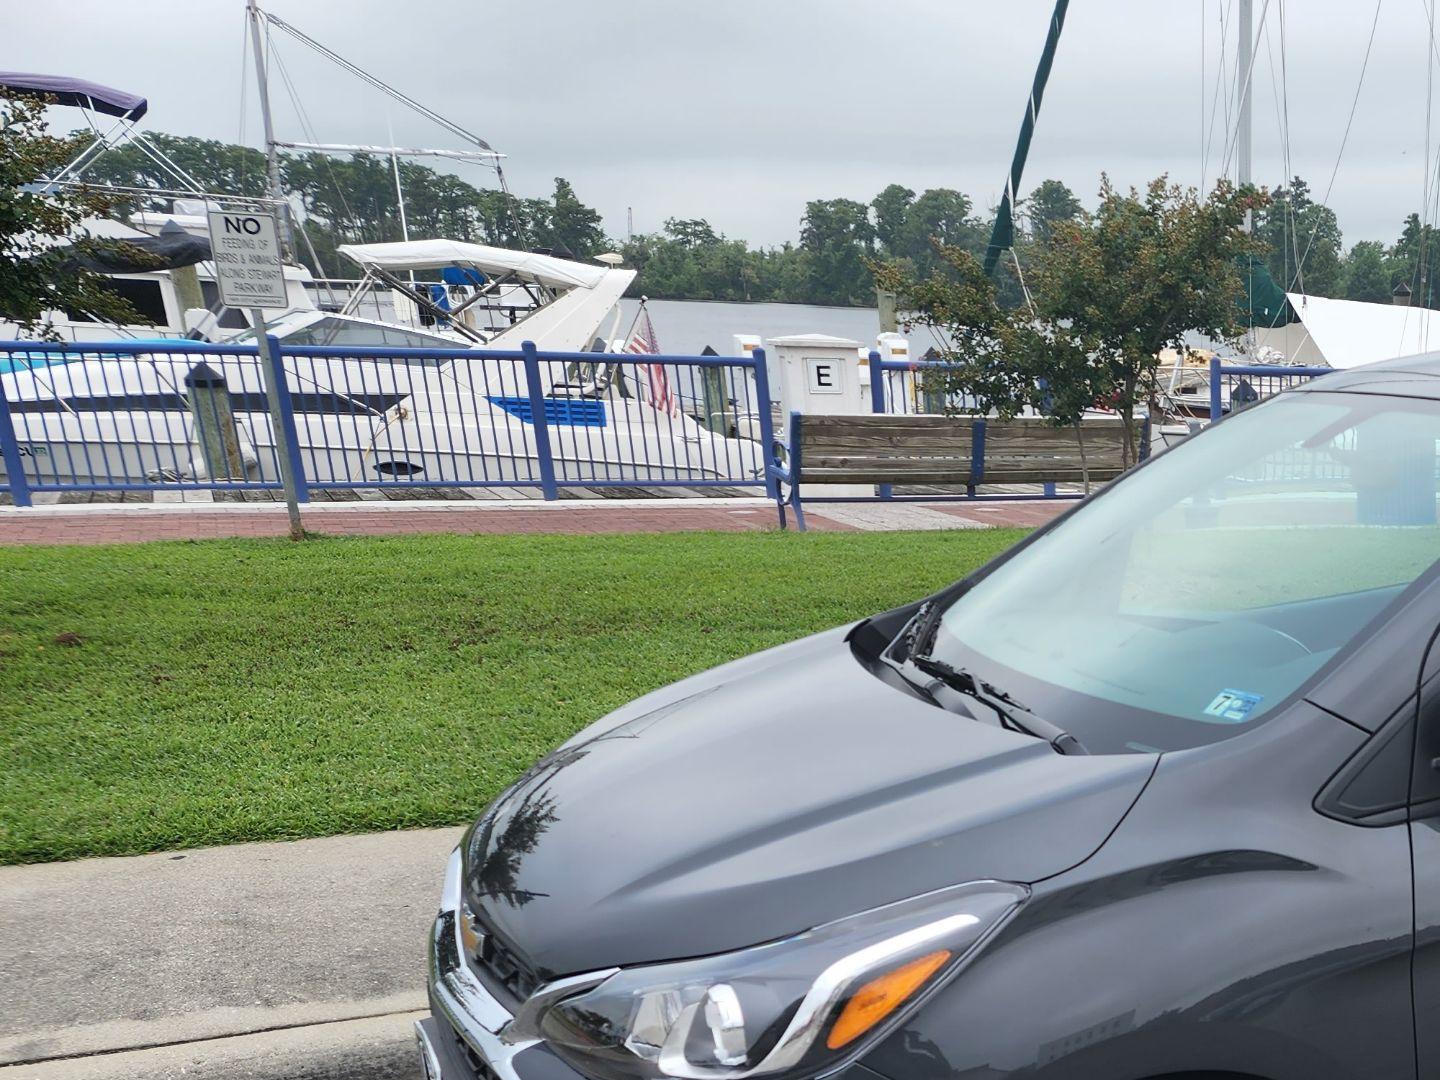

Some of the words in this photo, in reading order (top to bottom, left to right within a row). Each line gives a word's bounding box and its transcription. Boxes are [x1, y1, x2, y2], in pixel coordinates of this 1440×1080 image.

[224, 216, 261, 235] NO
[221, 237, 255, 250] FEEDING
[258, 239, 269, 250] OF
[216, 252, 238, 264] BIRDS
[248, 254, 281, 266] ANIMALS
[219, 267, 246, 279] ALONG
[233, 282, 273, 294] PARKWAY
[816, 365, 833, 387] E
